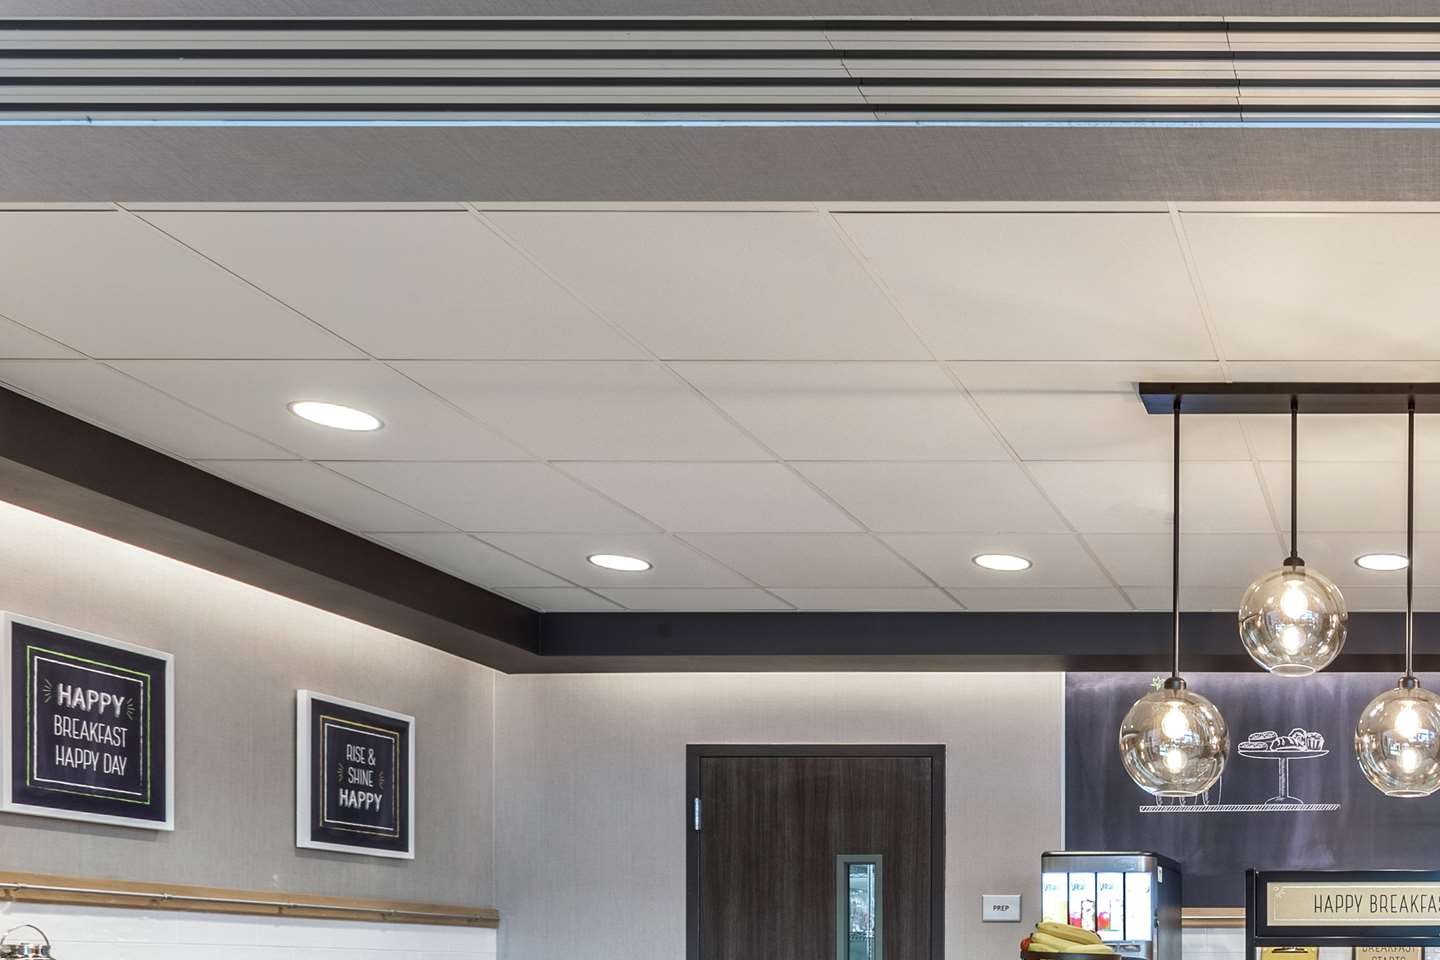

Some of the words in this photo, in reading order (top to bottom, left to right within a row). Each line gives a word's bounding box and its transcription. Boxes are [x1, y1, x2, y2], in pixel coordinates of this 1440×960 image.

[58, 683, 125, 718] HAPPY
[54, 714, 128, 748] BREAKFAST
[55, 744, 100, 772] HAPPY
[103, 752, 127, 776] DAY
[346, 744, 366, 764] RISE
[368, 748, 376, 766] &
[348, 766, 374, 787] SHINE
[339, 788, 383, 812] HAPPY
[1314, 894, 1363, 914] HAPPY
